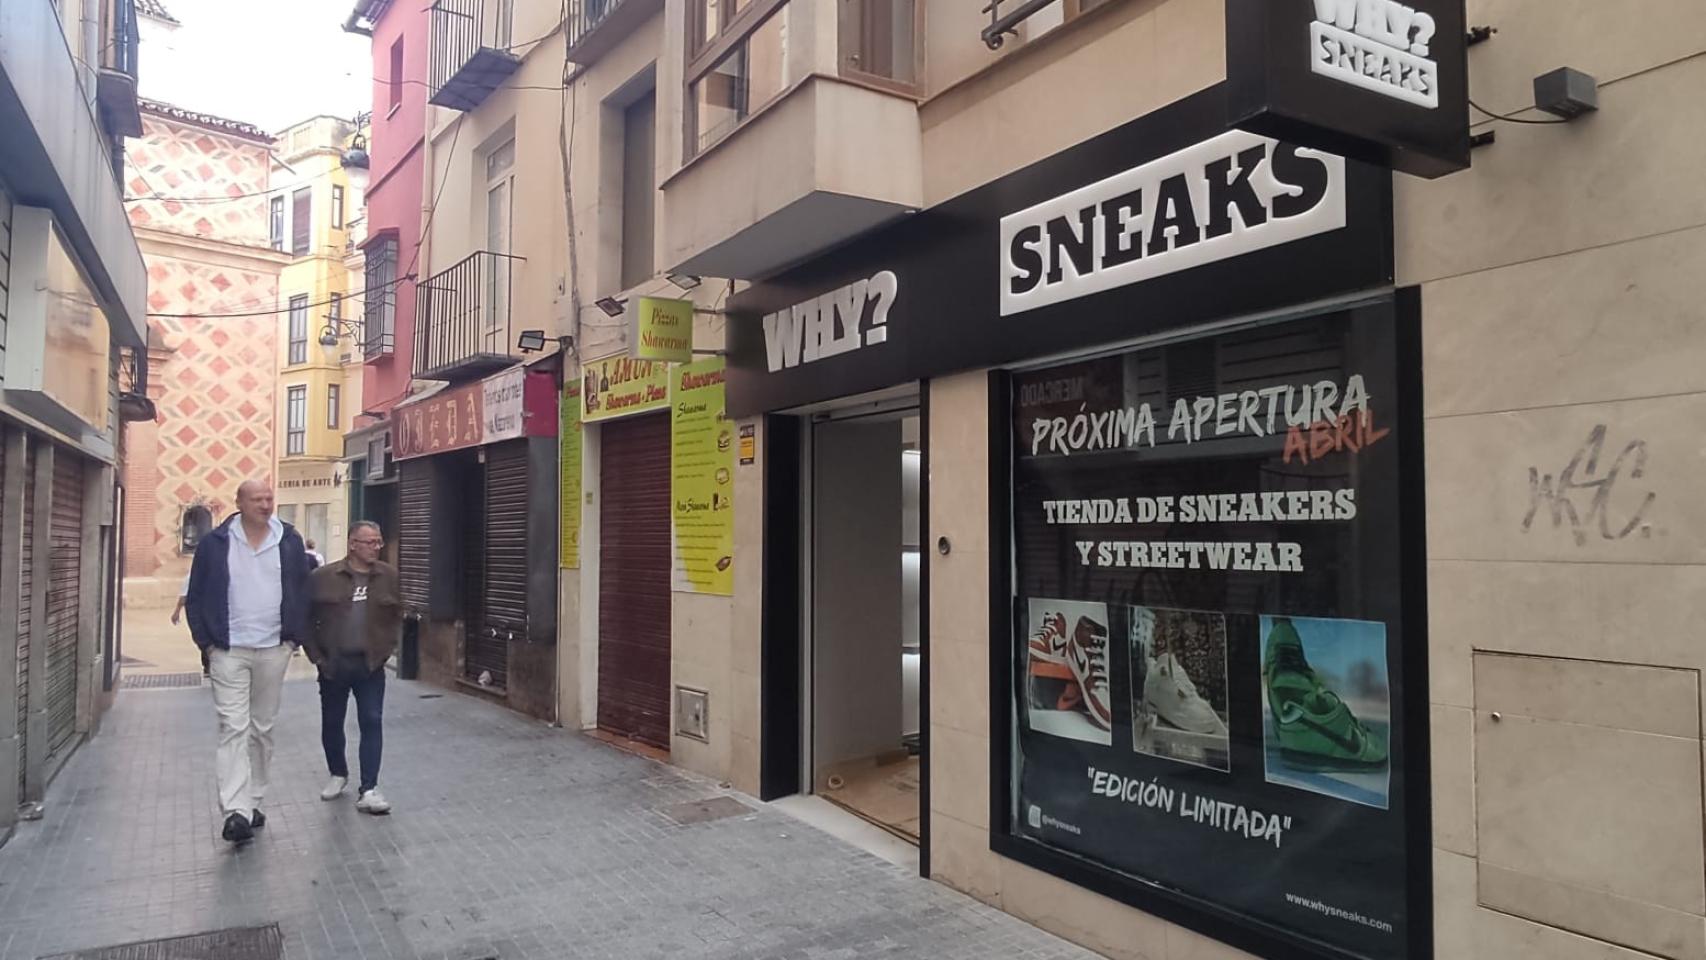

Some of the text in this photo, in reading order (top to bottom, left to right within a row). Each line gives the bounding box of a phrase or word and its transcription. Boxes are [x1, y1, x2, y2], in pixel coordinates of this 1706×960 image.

[1319, 33, 1430, 97] SNEAKS
[1009, 140, 1329, 295] SNEAKS
[762, 269, 898, 373] WHY?
[1031, 374, 1372, 456] PRÓXIMA APERTURA
[1282, 408, 1391, 465] ABRIL
[1043, 488, 1358, 525] TIENDA DE SNEAKERS
[1076, 541, 1304, 572] Y STREETWEAR
[1087, 766, 1292, 849] "EDICIÓN LIMITADA"
[1285, 893, 1393, 934] www.whysneaks.com
